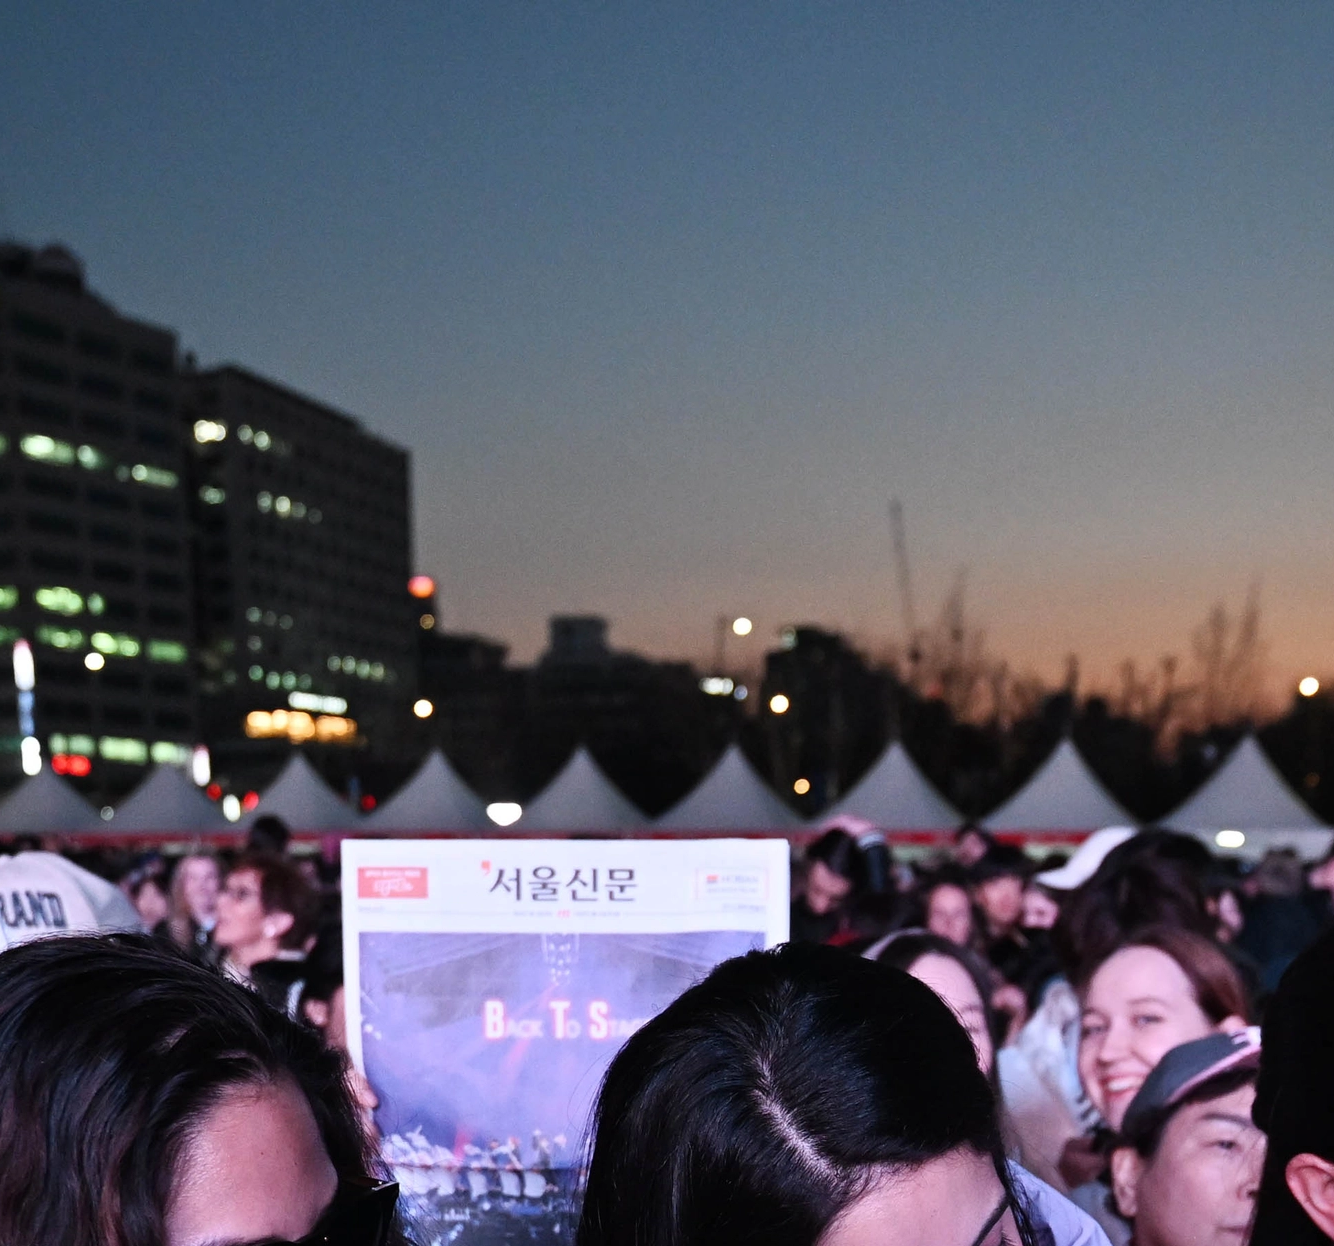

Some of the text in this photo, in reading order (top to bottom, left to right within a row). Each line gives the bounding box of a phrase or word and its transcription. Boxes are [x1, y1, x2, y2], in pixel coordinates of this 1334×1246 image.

[490, 866, 638, 902] 서울신문
[485, 1001, 543, 1039] BACK
[549, 1001, 581, 1039] TO
